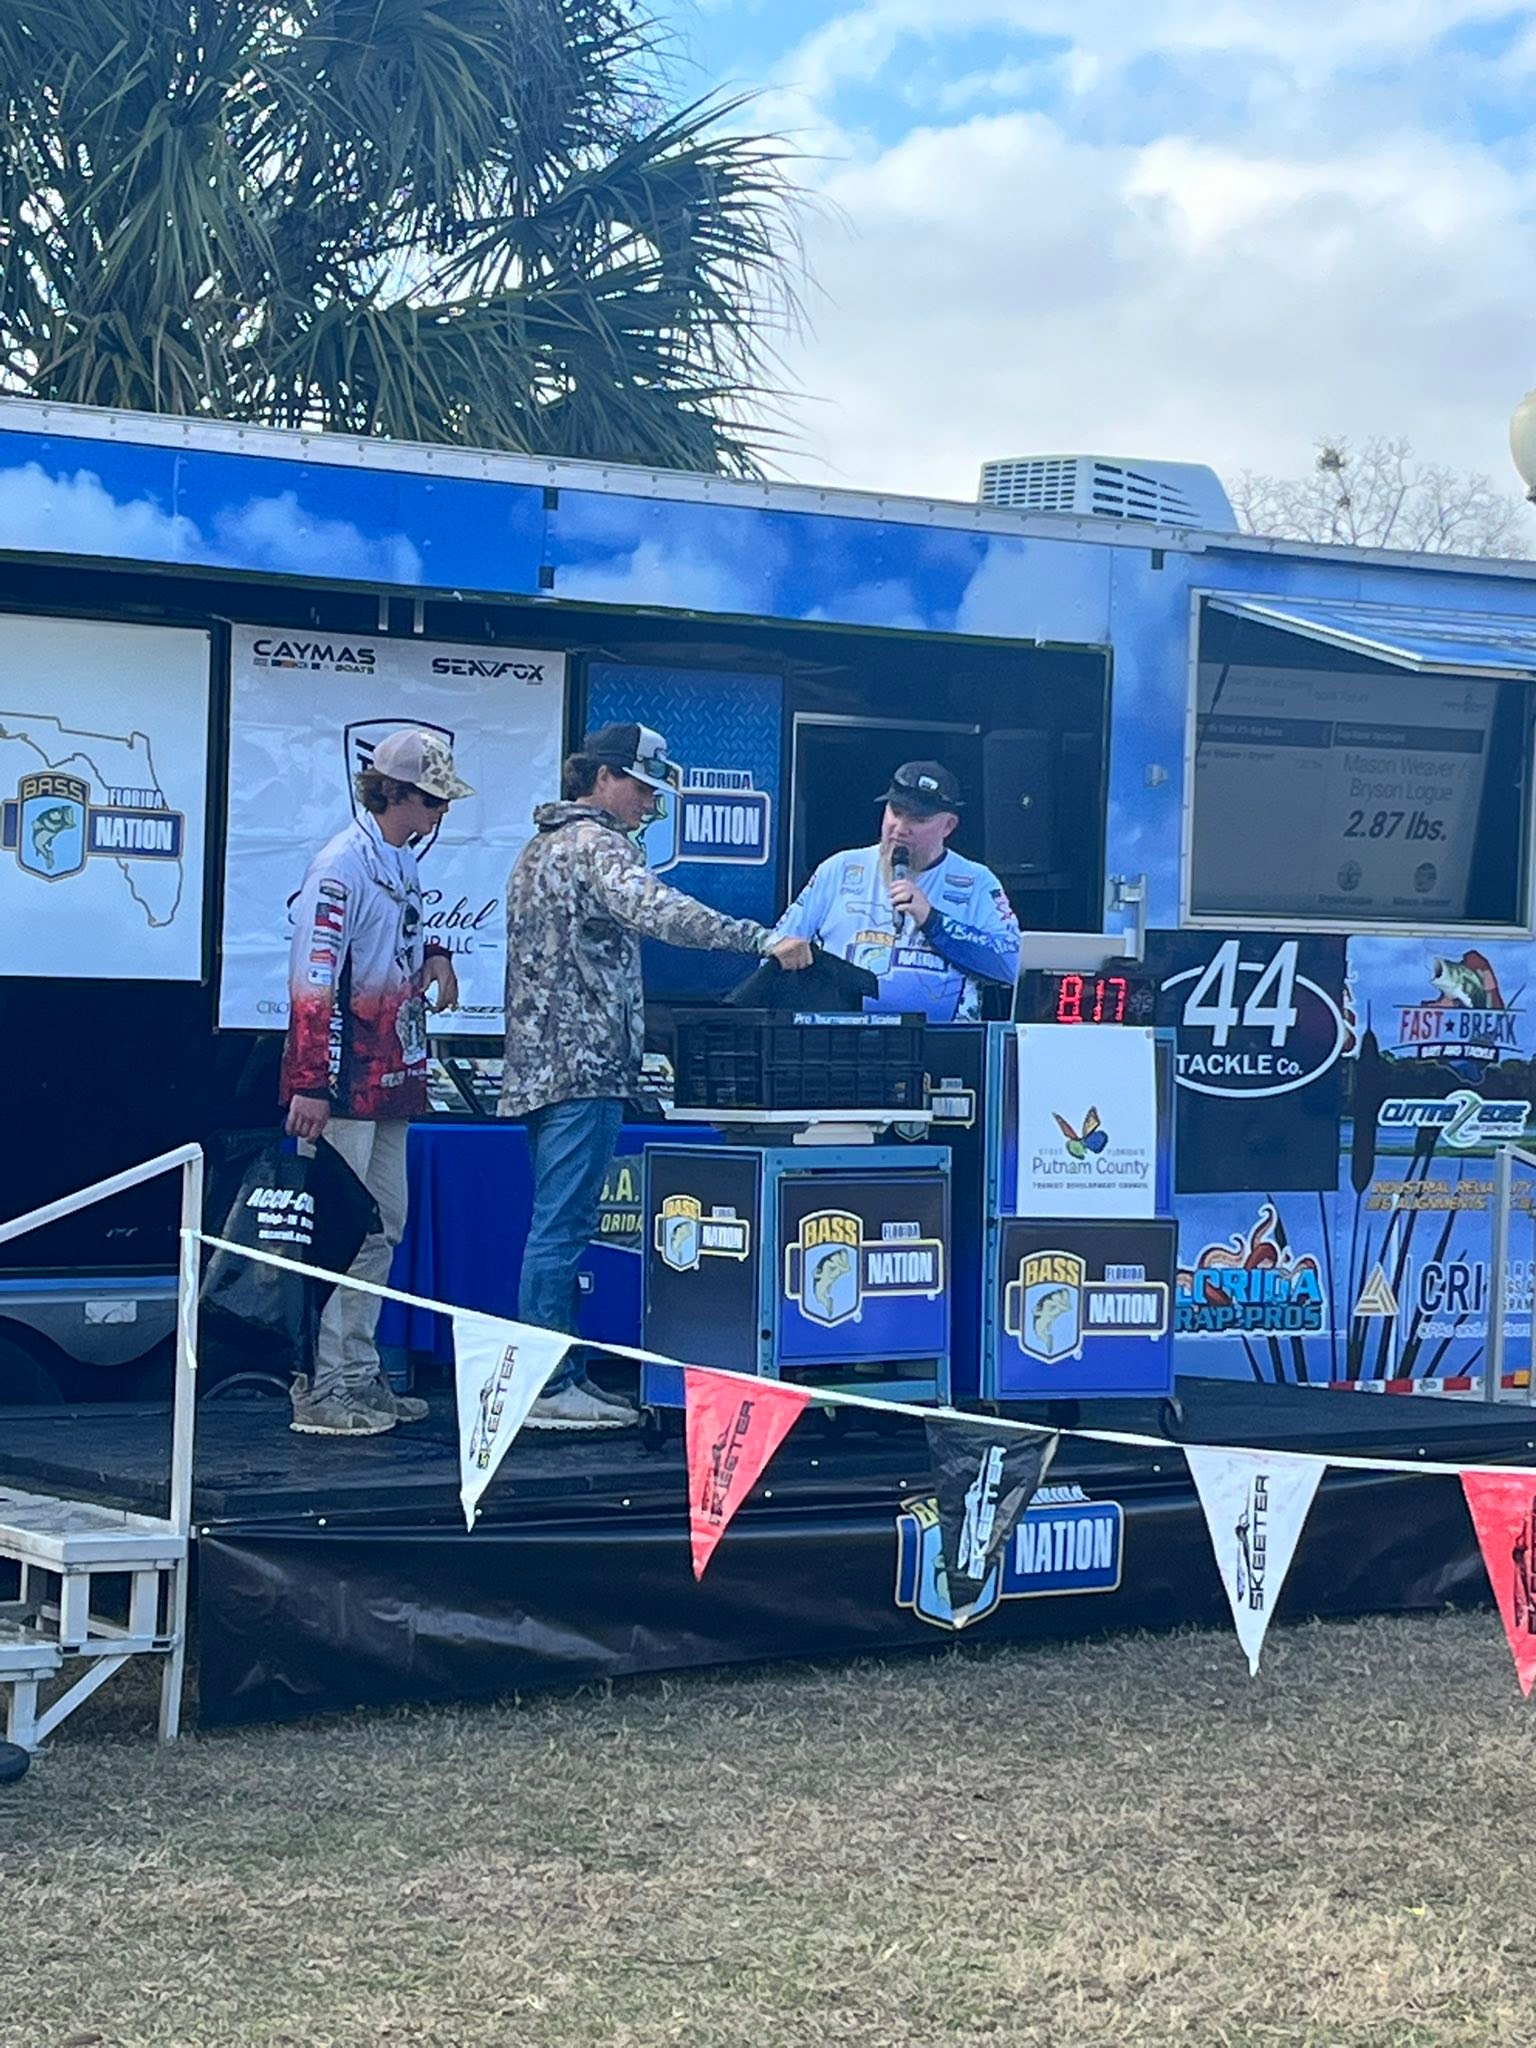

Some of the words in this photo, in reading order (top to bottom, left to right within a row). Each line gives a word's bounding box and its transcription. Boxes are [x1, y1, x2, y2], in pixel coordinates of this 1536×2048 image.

[253, 639, 376, 665] CAYMAS
[692, 770, 752, 789] FLORIDA
[1344, 754, 1396, 775] Mason
[1401, 757, 1455, 778] Weaver
[23, 778, 83, 803] BASS
[109, 788, 164, 809] FLORIDA
[1350, 778, 1402, 802] Bryson
[1406, 782, 1454, 805] Logue
[95, 816, 172, 850] NATION
[685, 804, 760, 845] NATION
[1343, 810, 1405, 838] 2.87
[1405, 811, 1447, 841] lbs.
[1183, 940, 1298, 1047] 44
[793, 1012, 812, 1025] Pro
[1400, 1010, 1444, 1041] FAST
[1459, 1012, 1518, 1046] BREAK
[1176, 1054, 1272, 1075] TACKLE
[1032, 1156, 1092, 1175] Putnam
[1096, 1156, 1150, 1180] County
[595, 1213, 643, 1233] ORIDA
[702, 1225, 743, 1249] NATION
[804, 1217, 857, 1248] BASS
[868, 1251, 933, 1284] NATION
[1026, 1257, 1079, 1287] BASS
[1106, 1266, 1143, 1281] FLORIDA
[1175, 1268, 1322, 1303] LORIDA
[1420, 1264, 1483, 1311] CRI
[1089, 1293, 1157, 1324] NATION
[1174, 1306, 1234, 1330] RAP
[1244, 1306, 1322, 1330] PROS
[476, 1344, 519, 1470] SKEETER
[1015, 1518, 1113, 1575] NATION
[1249, 1474, 1270, 1611] SKEETER
